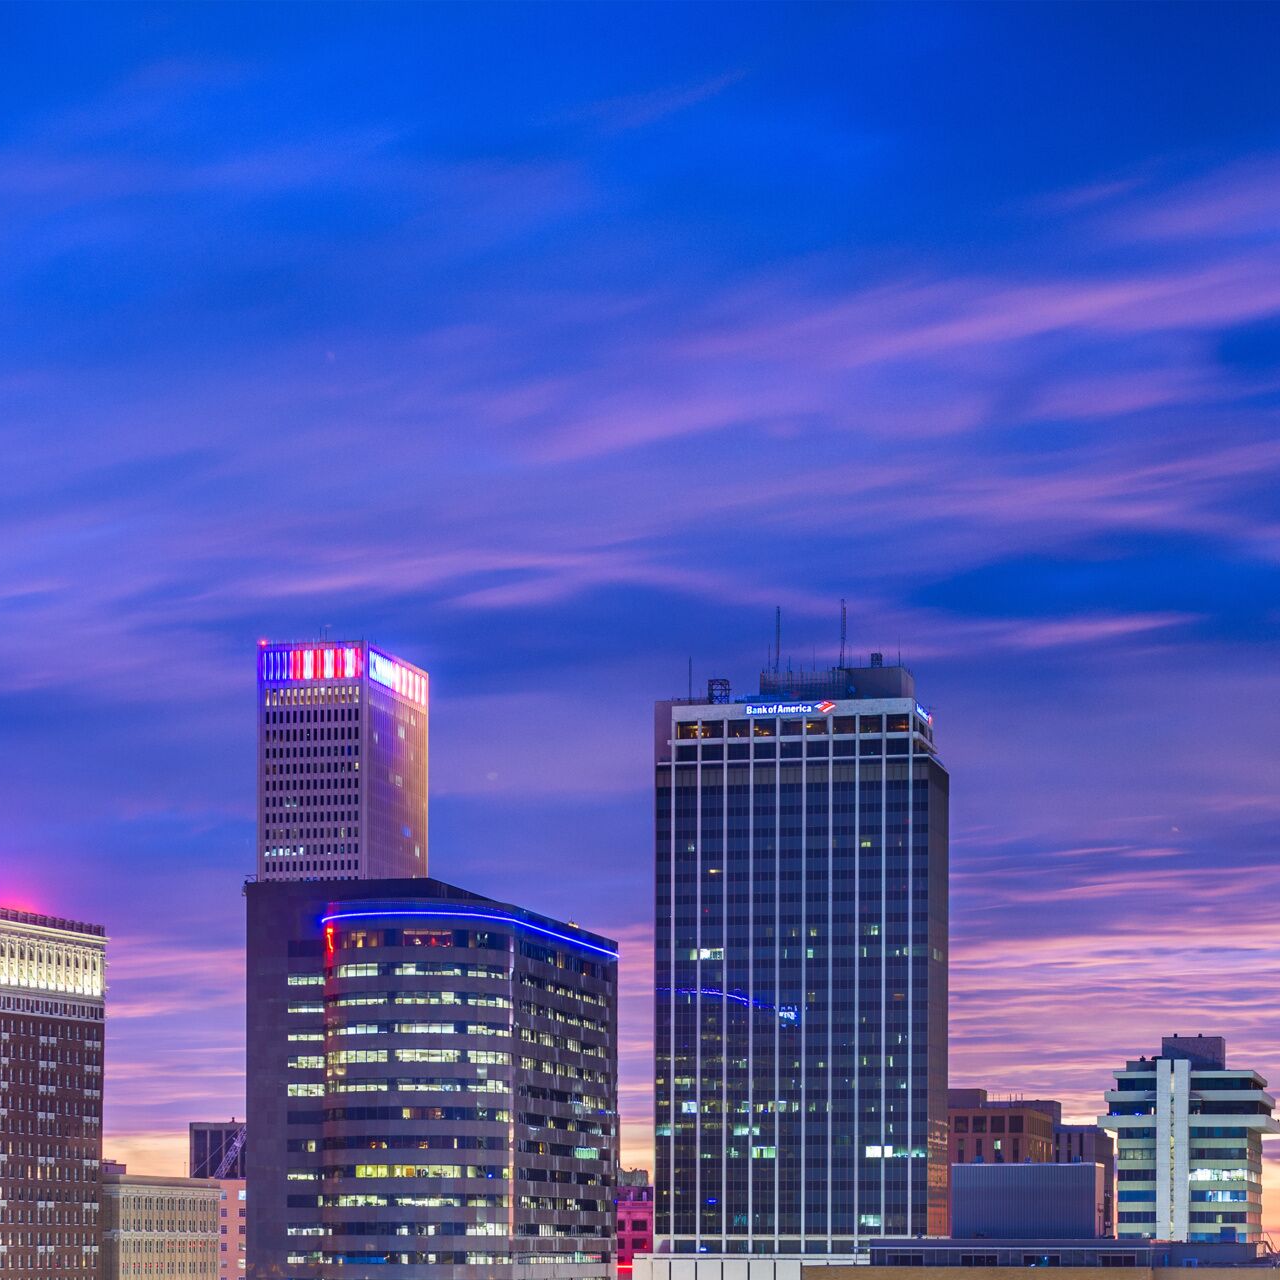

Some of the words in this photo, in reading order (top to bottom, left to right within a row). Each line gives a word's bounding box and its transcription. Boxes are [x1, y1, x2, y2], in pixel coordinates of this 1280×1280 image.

[746, 705, 767, 714] Bank
[768, 704, 777, 713] of
[777, 703, 812, 713] America
